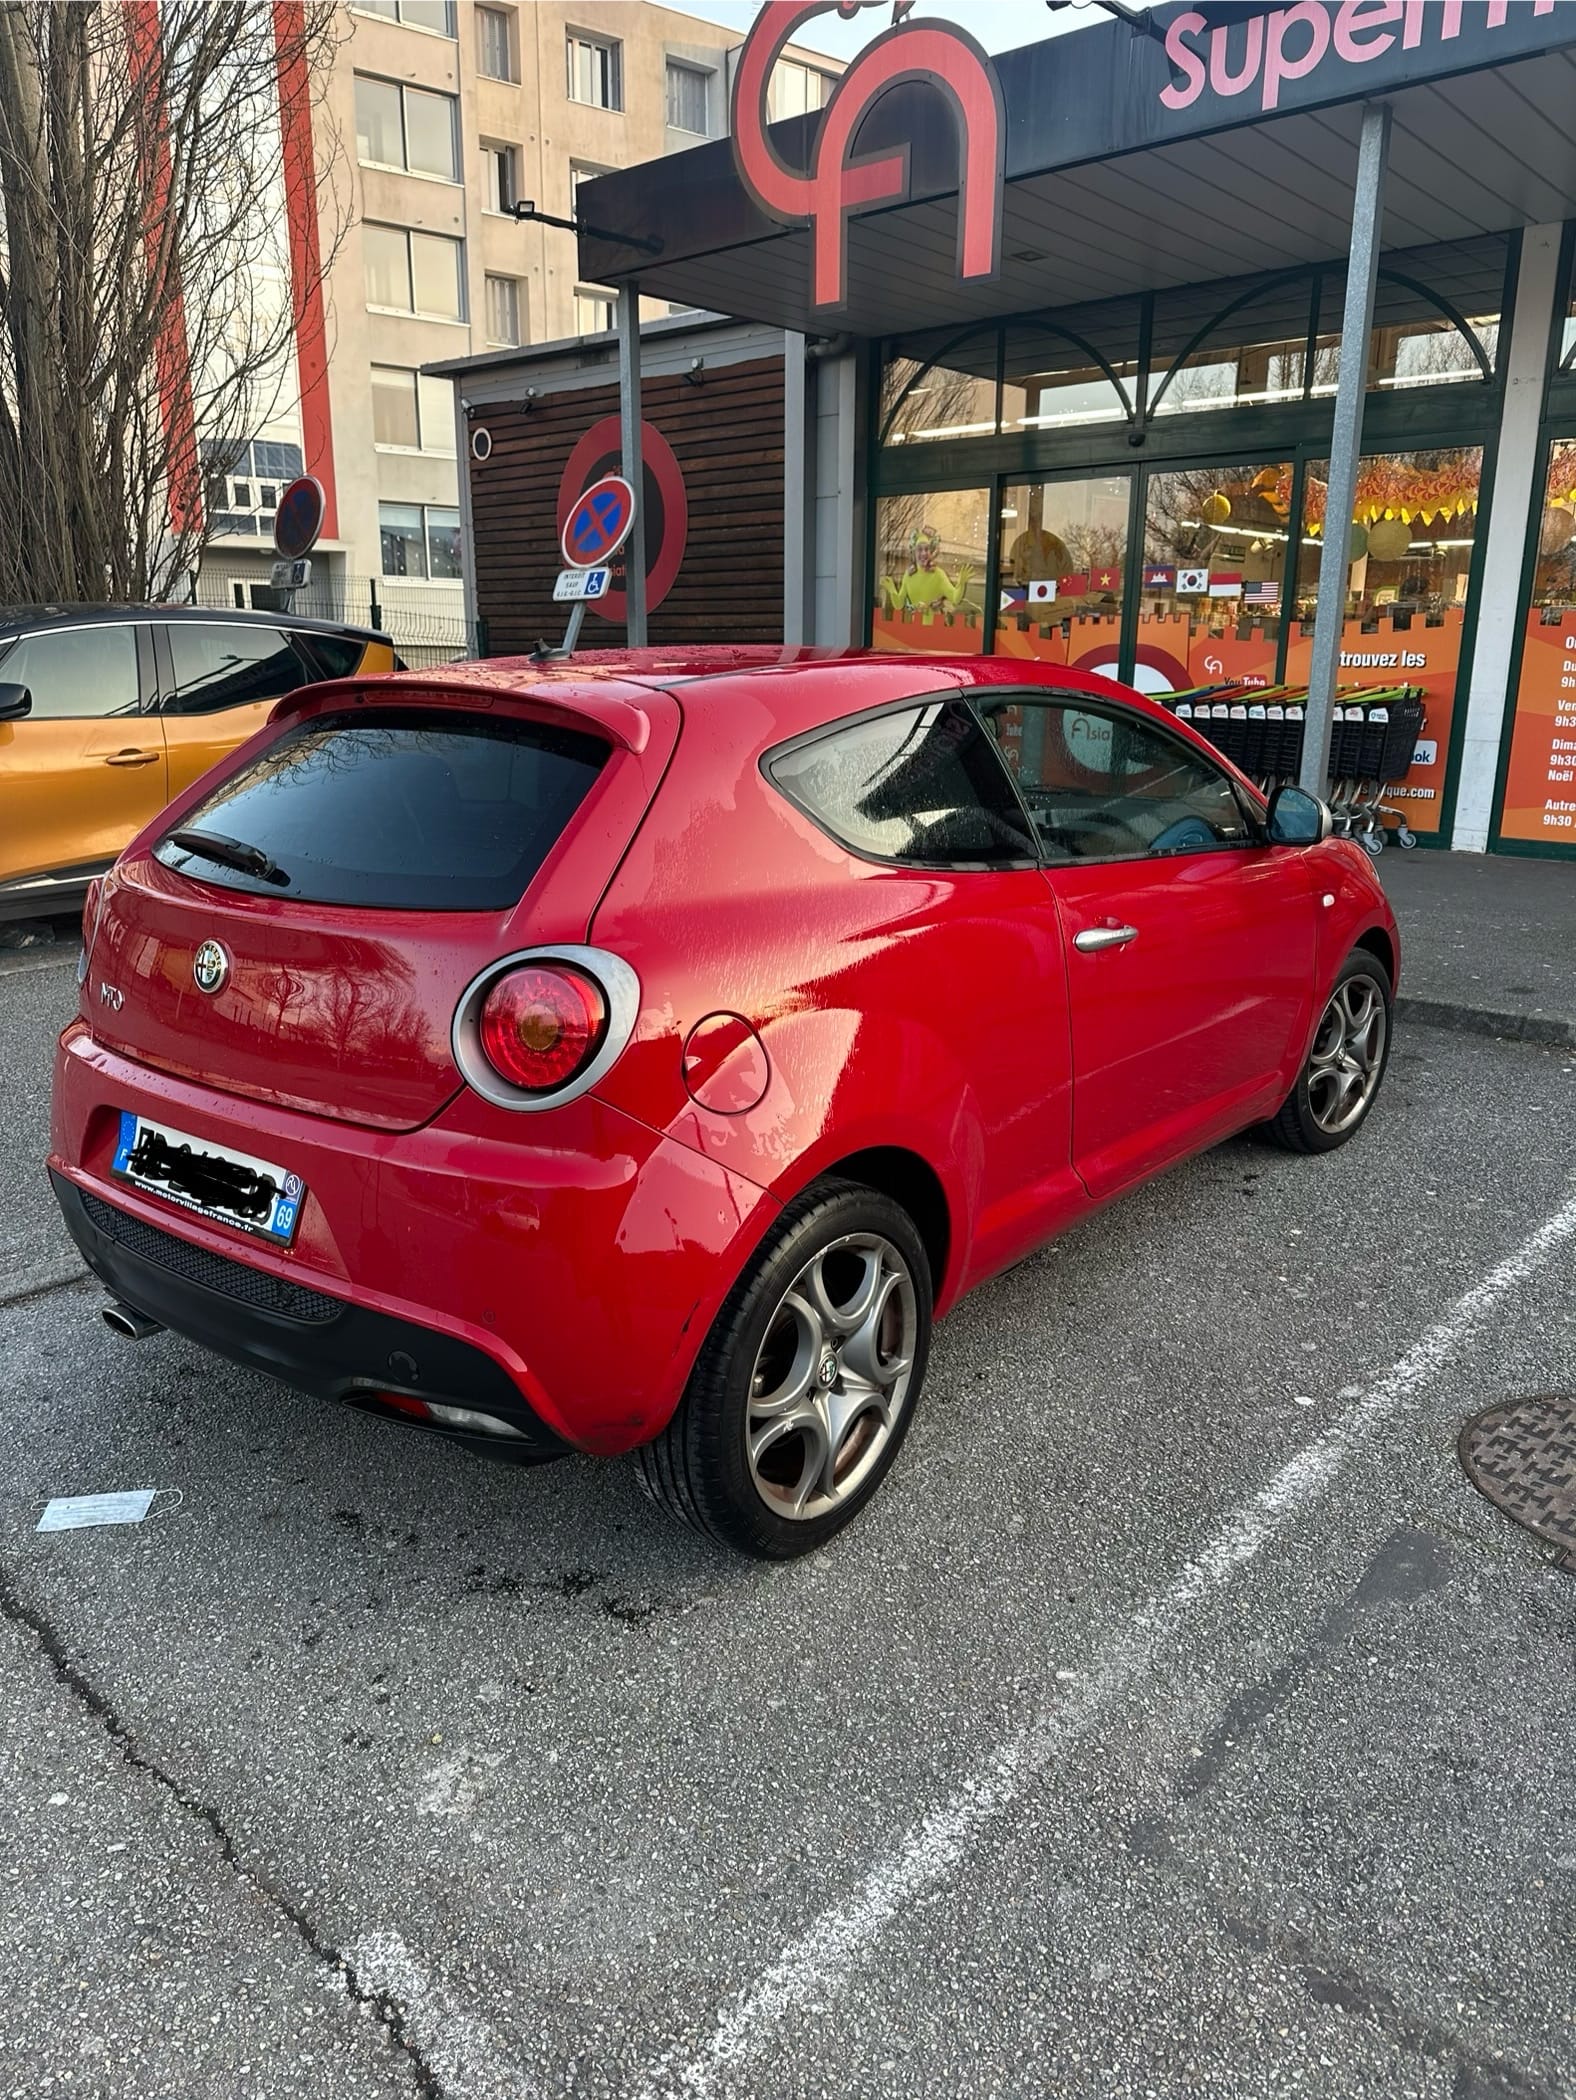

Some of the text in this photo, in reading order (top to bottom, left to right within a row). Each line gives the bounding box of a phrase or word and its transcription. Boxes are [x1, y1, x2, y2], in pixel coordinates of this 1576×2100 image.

[1340, 650, 1426, 667] trouvez les
[1547, 768, 1573, 782] Noël
[1543, 814, 1572, 827] 9h30
[276, 1204, 294, 1230] 69
